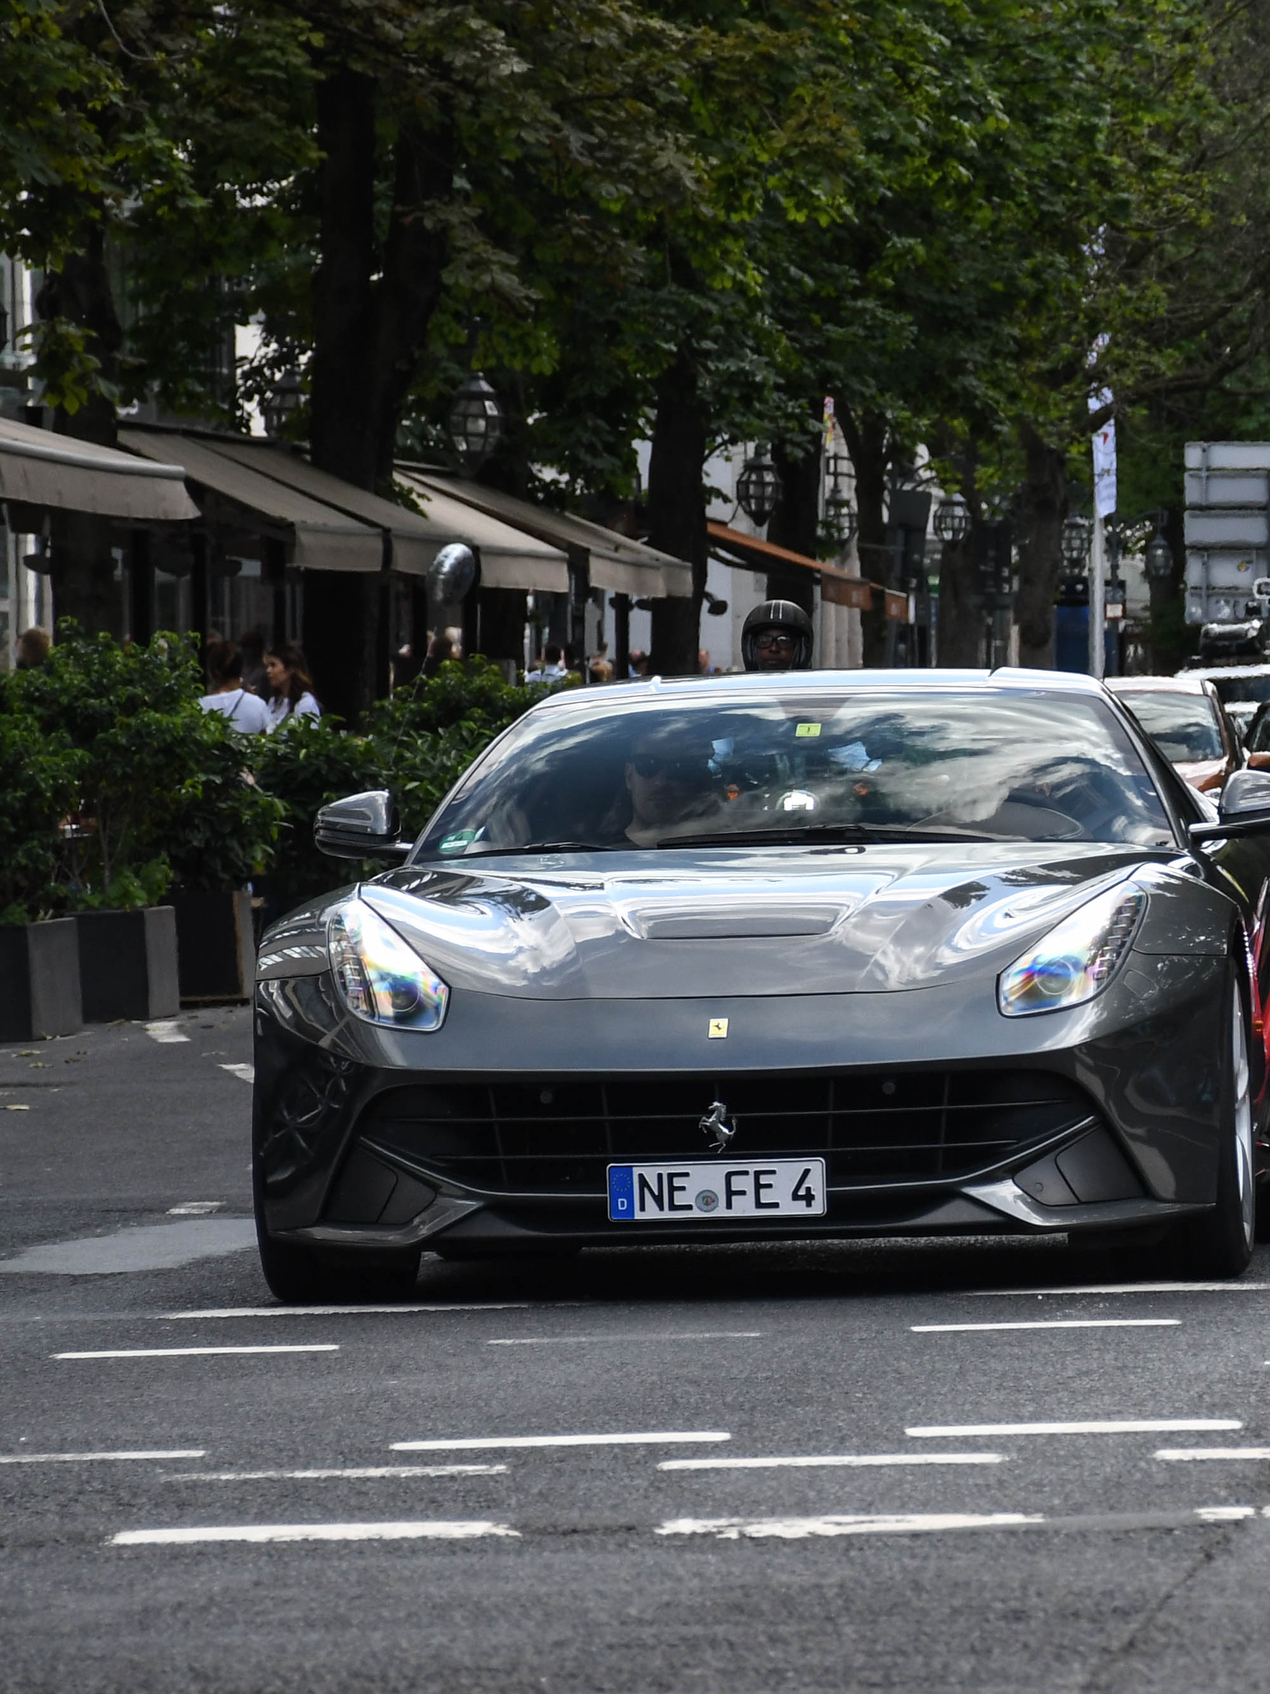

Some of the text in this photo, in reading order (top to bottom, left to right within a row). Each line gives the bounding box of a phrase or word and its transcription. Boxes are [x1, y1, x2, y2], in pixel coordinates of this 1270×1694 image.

[618, 1168, 816, 1212] D NE FE 4
